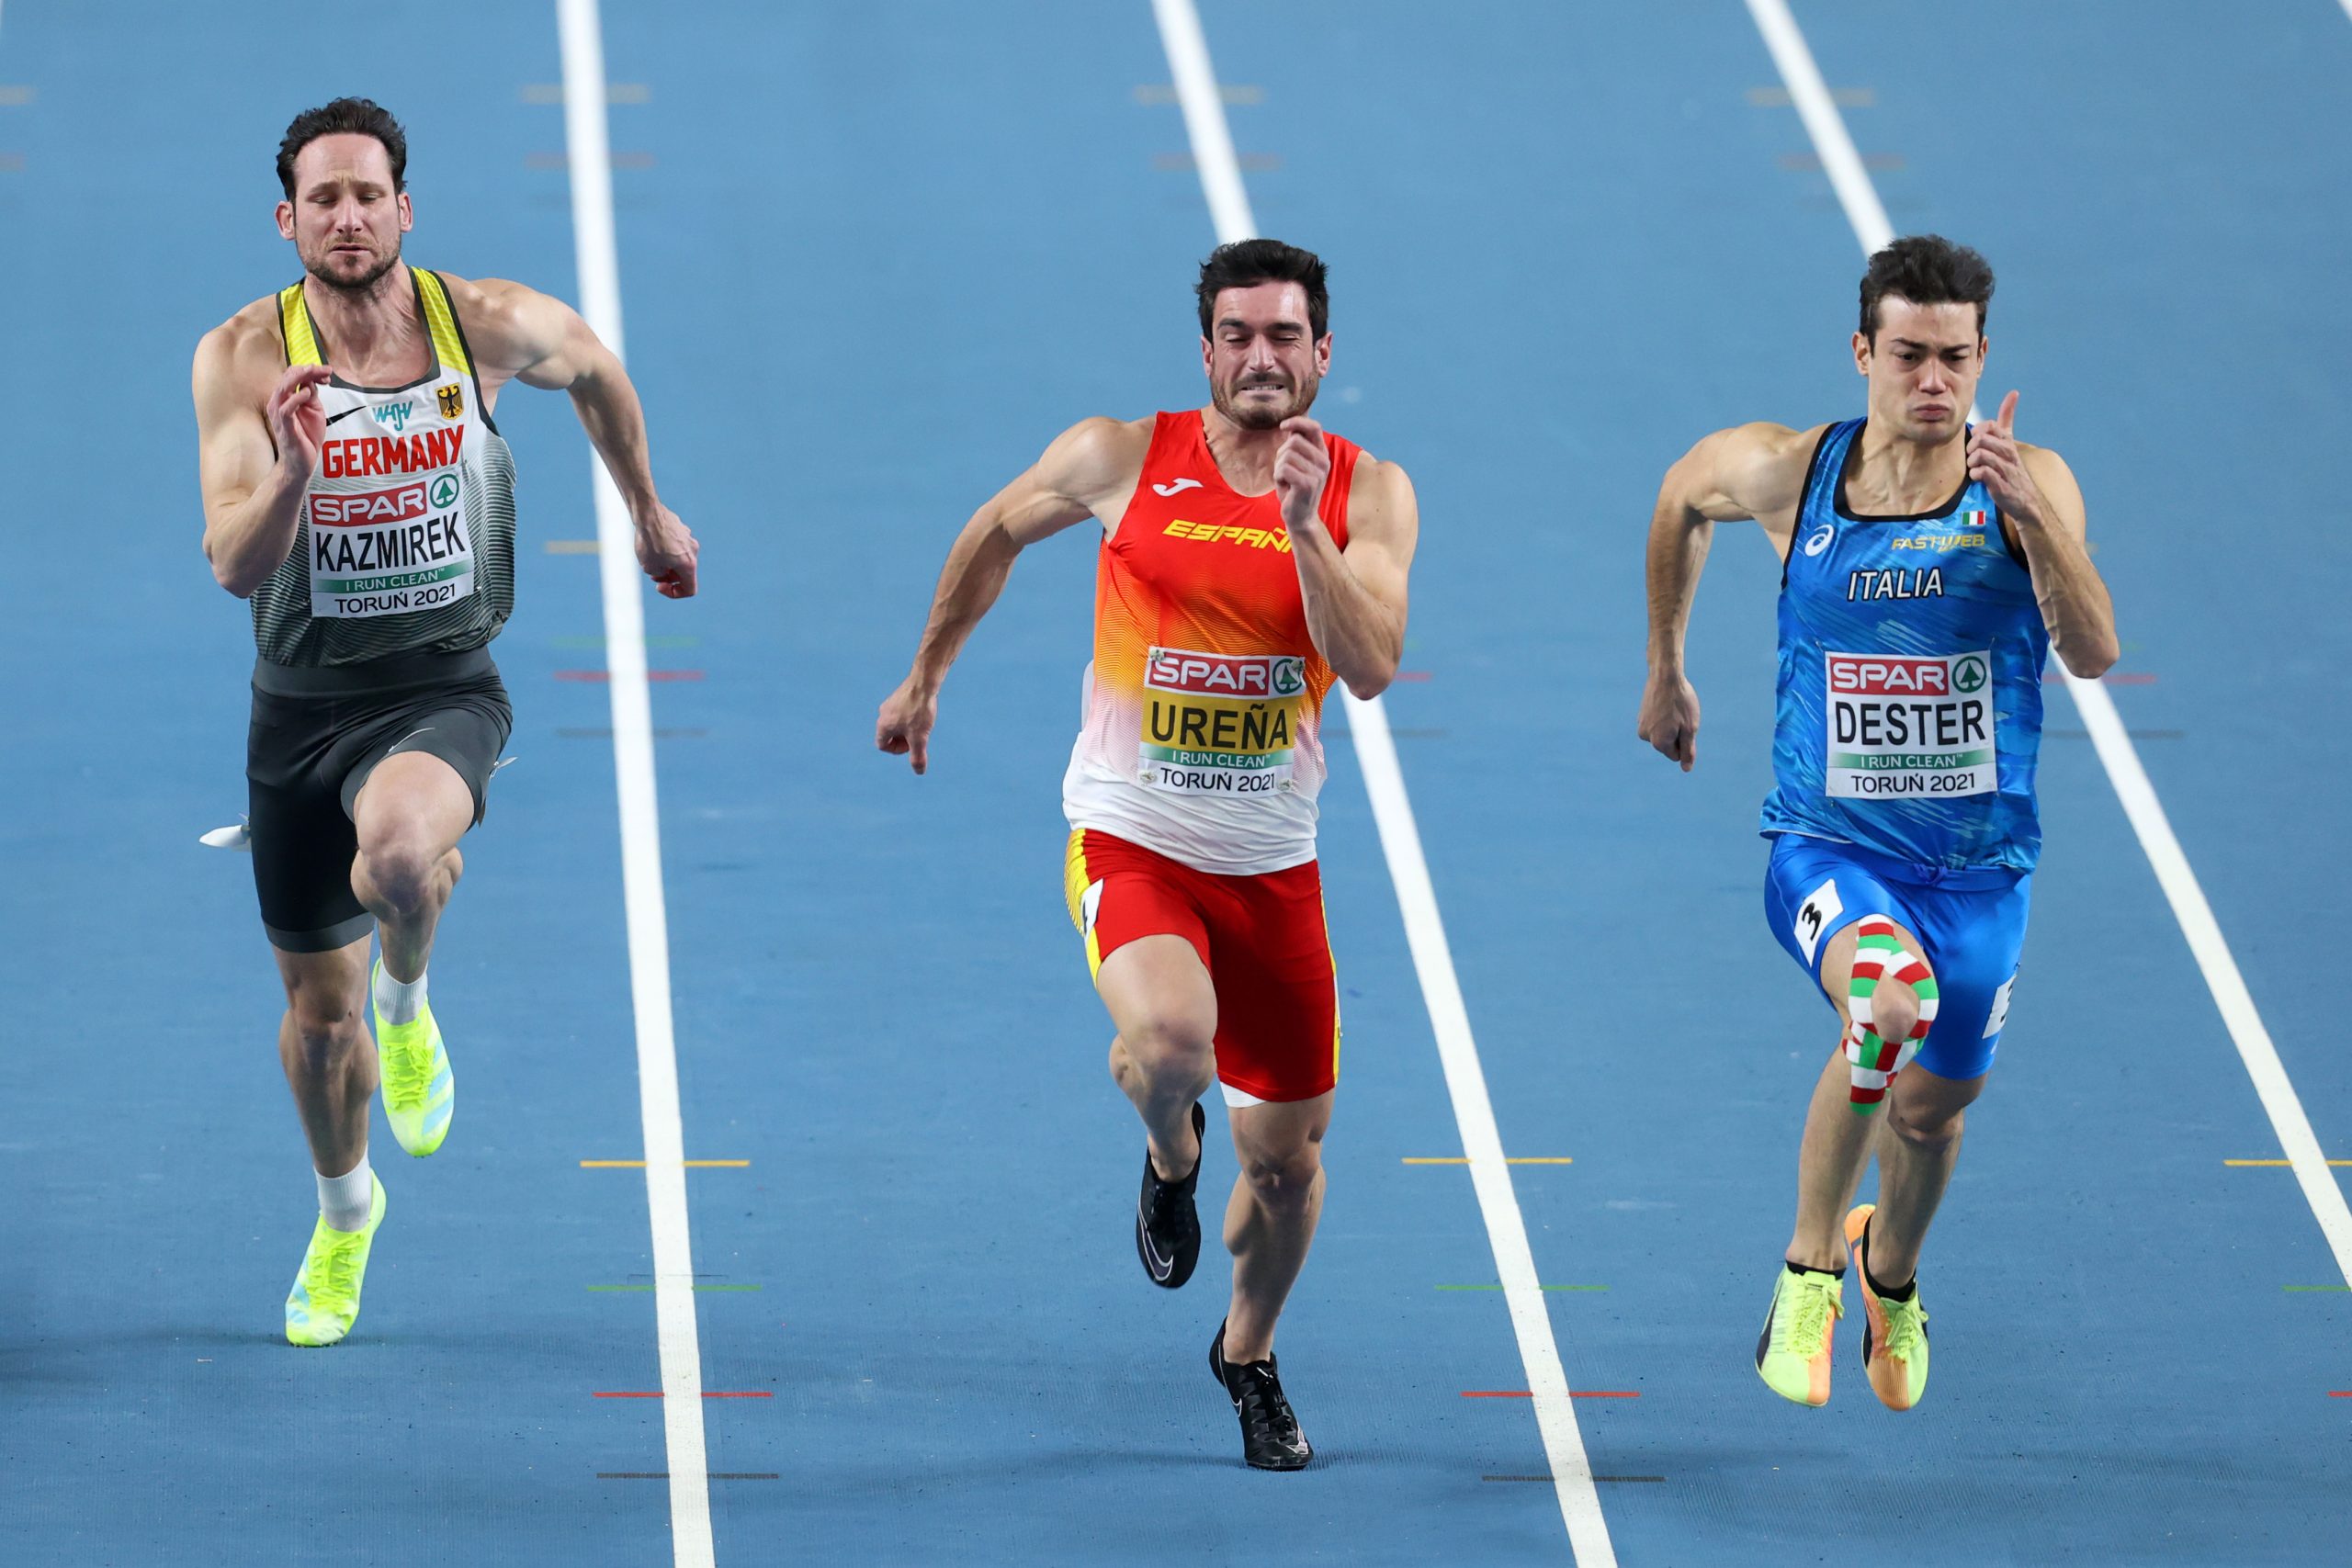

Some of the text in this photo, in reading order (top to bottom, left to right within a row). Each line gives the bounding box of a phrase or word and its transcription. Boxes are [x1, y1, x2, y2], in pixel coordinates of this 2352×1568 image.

[322, 424, 464, 479] GERMANY
[314, 490, 426, 523] SPAR
[315, 511, 466, 572] KAZMIREK
[1162, 519, 1292, 554] ESPAÑ
[1892, 534, 1985, 553] FASTWEB
[334, 583, 456, 614] TORUŃ 2021
[345, 581, 350, 592] I
[354, 578, 387, 592] RUN
[1847, 567, 1944, 602] ITALIA
[1151, 659, 1268, 690] SPAR
[1832, 662, 1947, 691] SPAR
[1150, 701, 1288, 750] UREÑA
[1835, 699, 1986, 746] DESTER
[1172, 750, 1177, 761] I
[1180, 751, 1213, 765] RUN
[1860, 756, 1865, 768] I
[1868, 756, 1902, 768] RUN
[1160, 767, 1275, 792] TORUŃ 2021
[1850, 773, 1975, 794] TORUŃ 2021
[1801, 902, 1823, 942] 3
